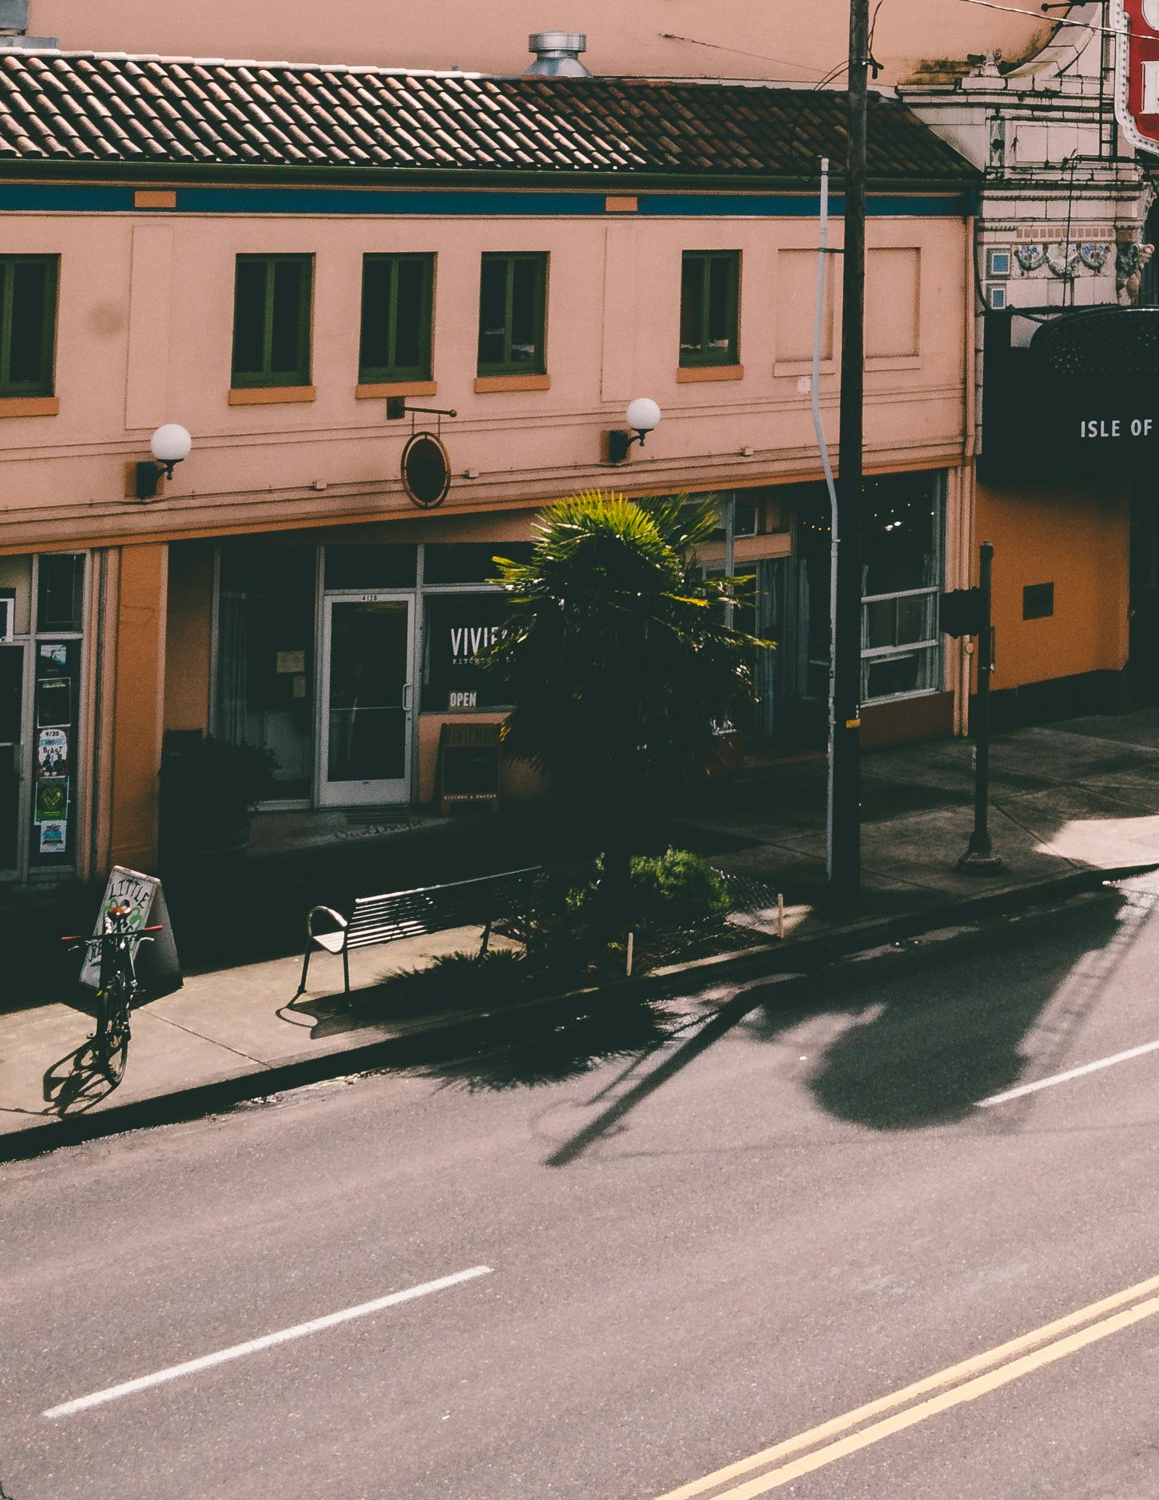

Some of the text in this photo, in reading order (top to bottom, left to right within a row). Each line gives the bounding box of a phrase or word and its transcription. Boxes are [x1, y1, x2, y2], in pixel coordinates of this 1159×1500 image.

[1080, 419, 1121, 438] ISLE
[1130, 418, 1153, 437] OF
[450, 626, 516, 657] VIVIE
[449, 692, 477, 707] OPEN
[109, 879, 150, 909] LITTLE
